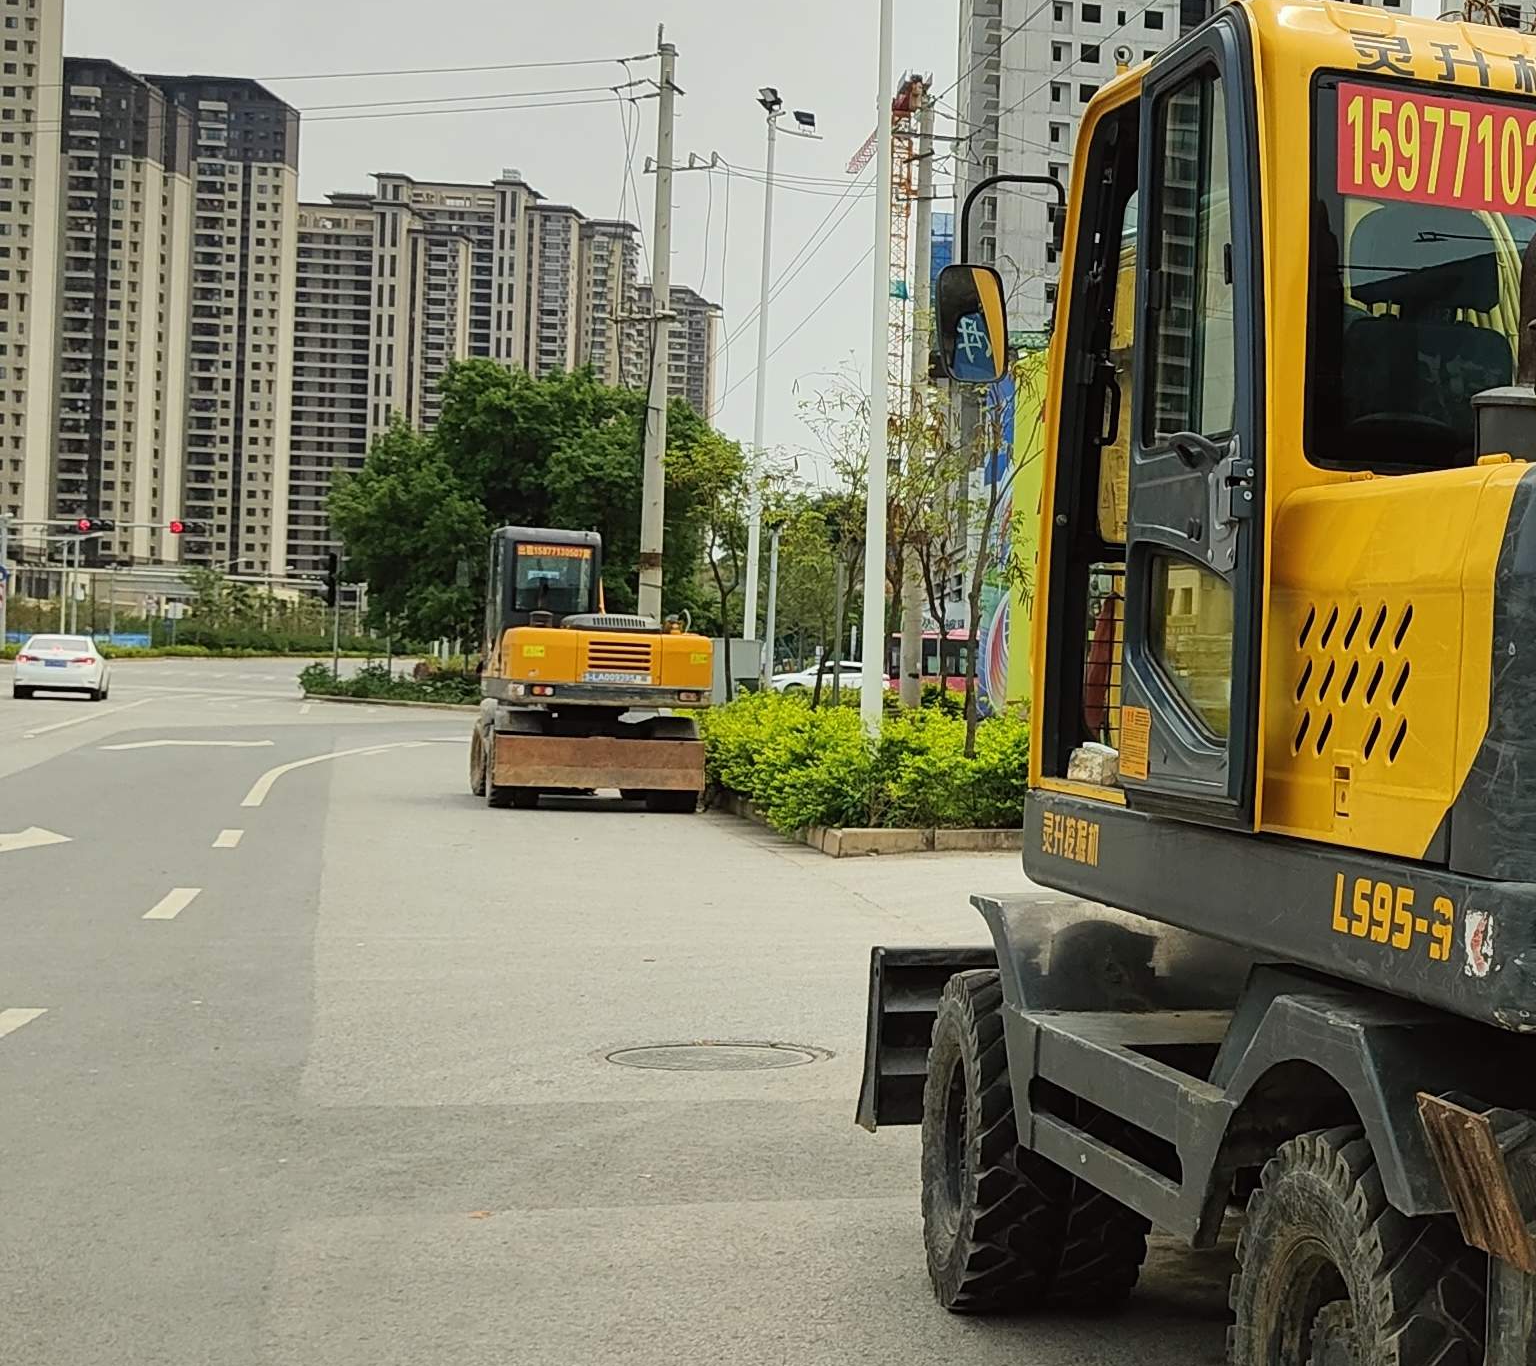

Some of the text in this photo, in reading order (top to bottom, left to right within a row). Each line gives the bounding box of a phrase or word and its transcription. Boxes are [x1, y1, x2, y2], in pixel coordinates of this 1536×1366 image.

[1041, 811, 1100, 867] 灵升挖掘机
